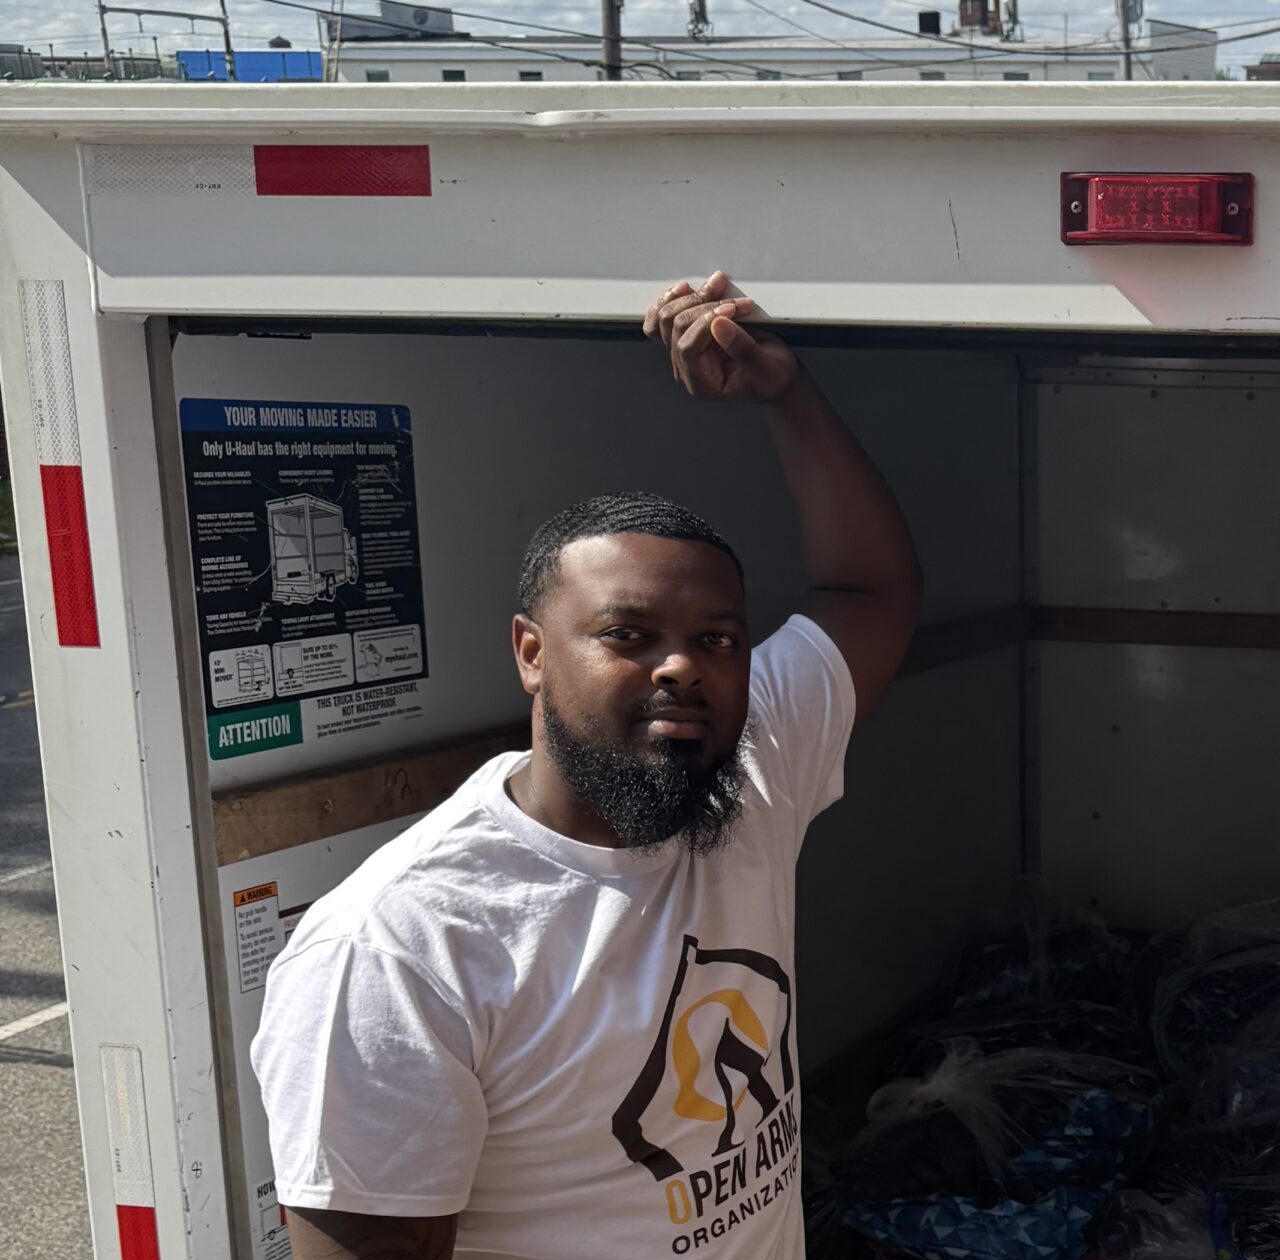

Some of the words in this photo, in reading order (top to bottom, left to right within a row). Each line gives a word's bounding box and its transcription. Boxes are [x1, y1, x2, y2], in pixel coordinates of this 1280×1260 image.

[224, 406, 257, 427] YOUR
[260, 407, 304, 428] MOVING
[307, 408, 338, 429] MADE
[342, 409, 377, 430] EASIER
[203, 441, 223, 459] Only
[226, 441, 255, 456] U-Haul
[258, 442, 273, 456] has
[276, 442, 289, 456] the
[292, 442, 310, 458] right
[313, 442, 354, 458] equipment
[357, 442, 367, 456] for
[317, 698, 331, 709] THIS
[333, 694, 353, 706] TRUCK
[355, 693, 362, 702] IS
[342, 704, 354, 716] NOT
[219, 714, 291, 748] ATTENTION
[665, 1146, 747, 1225] OPEN
[672, 1146, 799, 1255] ORGANIZATIO
